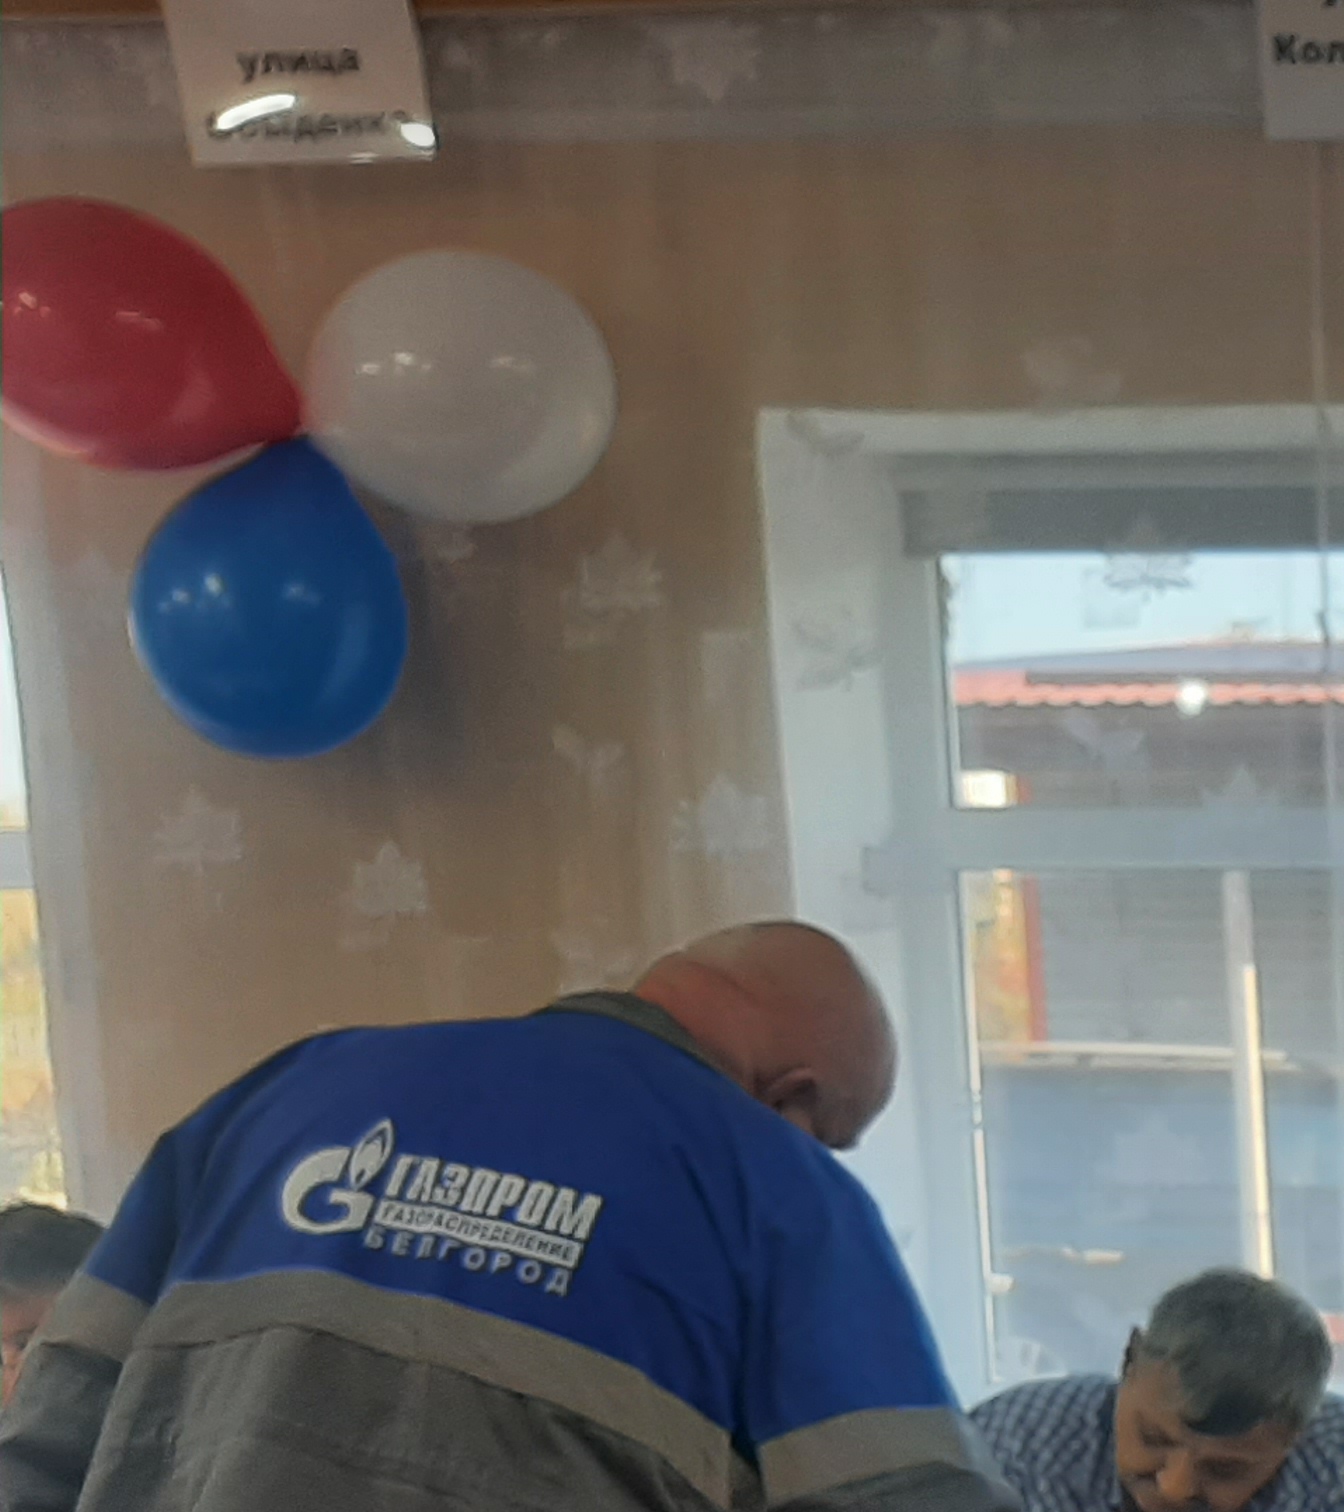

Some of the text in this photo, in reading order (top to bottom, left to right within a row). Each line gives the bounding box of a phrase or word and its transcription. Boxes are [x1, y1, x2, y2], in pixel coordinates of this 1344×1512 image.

[234, 47, 361, 85] улица
[385, 1154, 603, 1239] ГАЗПРОМ
[363, 1226, 572, 1298] БЕЛГОРОД
